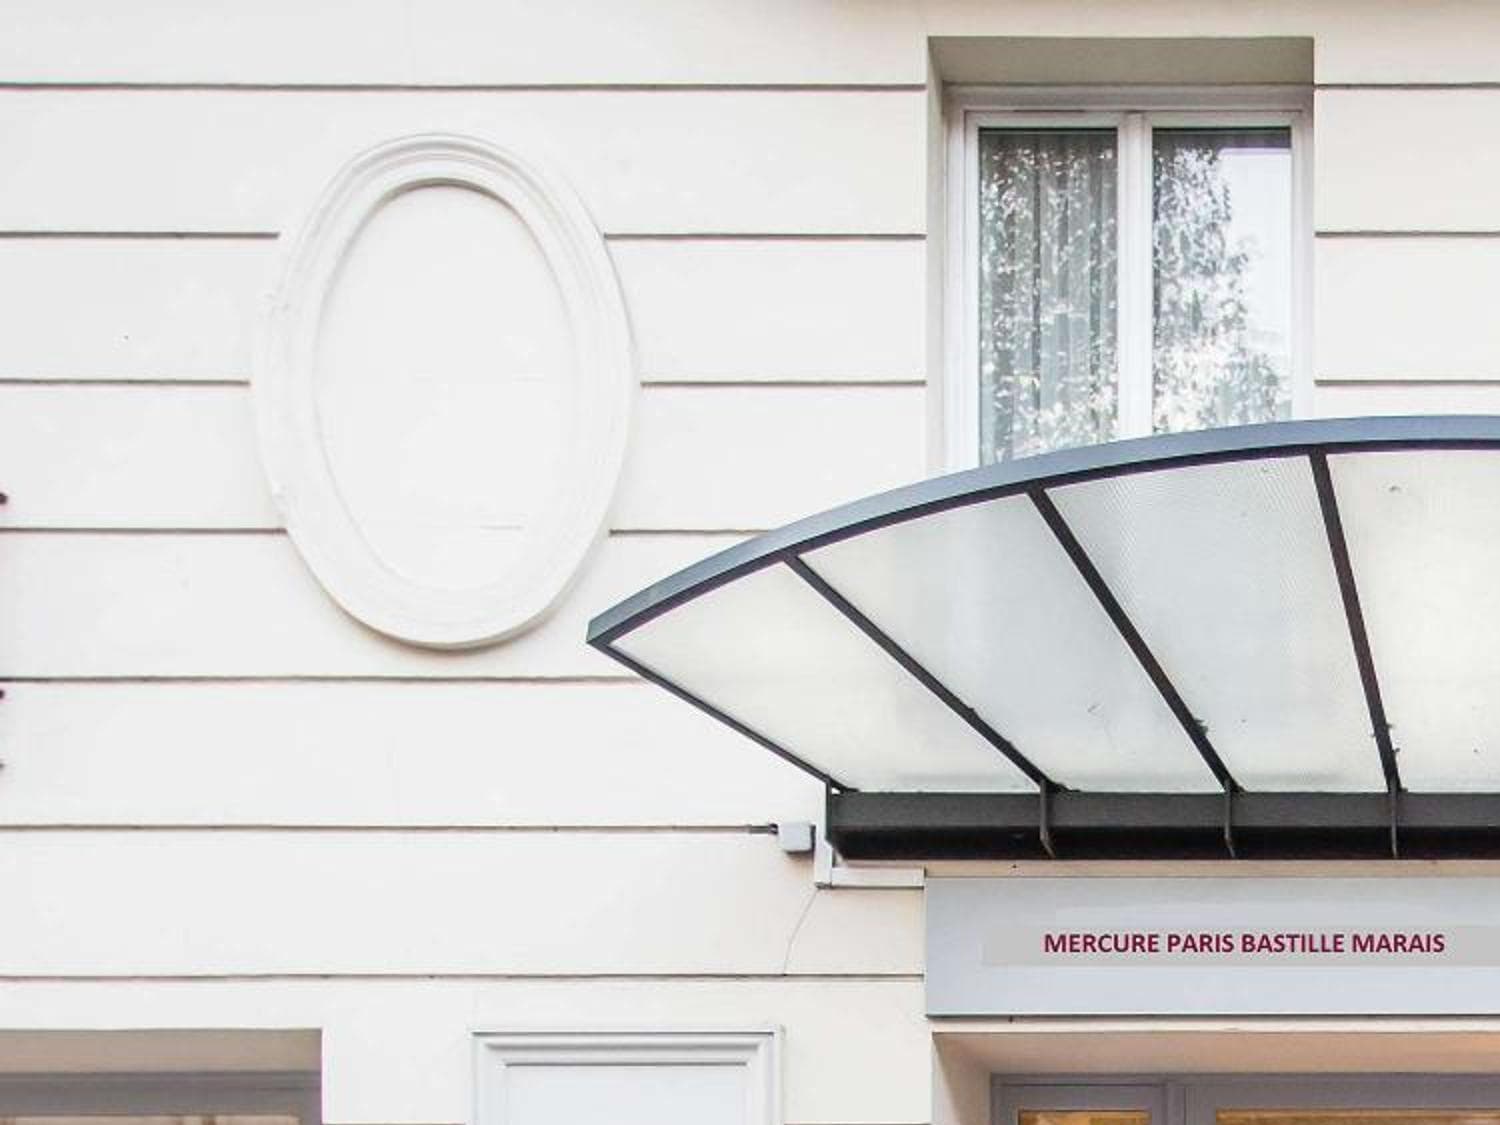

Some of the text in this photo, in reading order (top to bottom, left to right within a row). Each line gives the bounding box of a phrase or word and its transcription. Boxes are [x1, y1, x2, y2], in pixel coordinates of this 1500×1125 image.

[1044, 934, 1446, 953] MERCURE PARIS BASTILLE MARAIS
